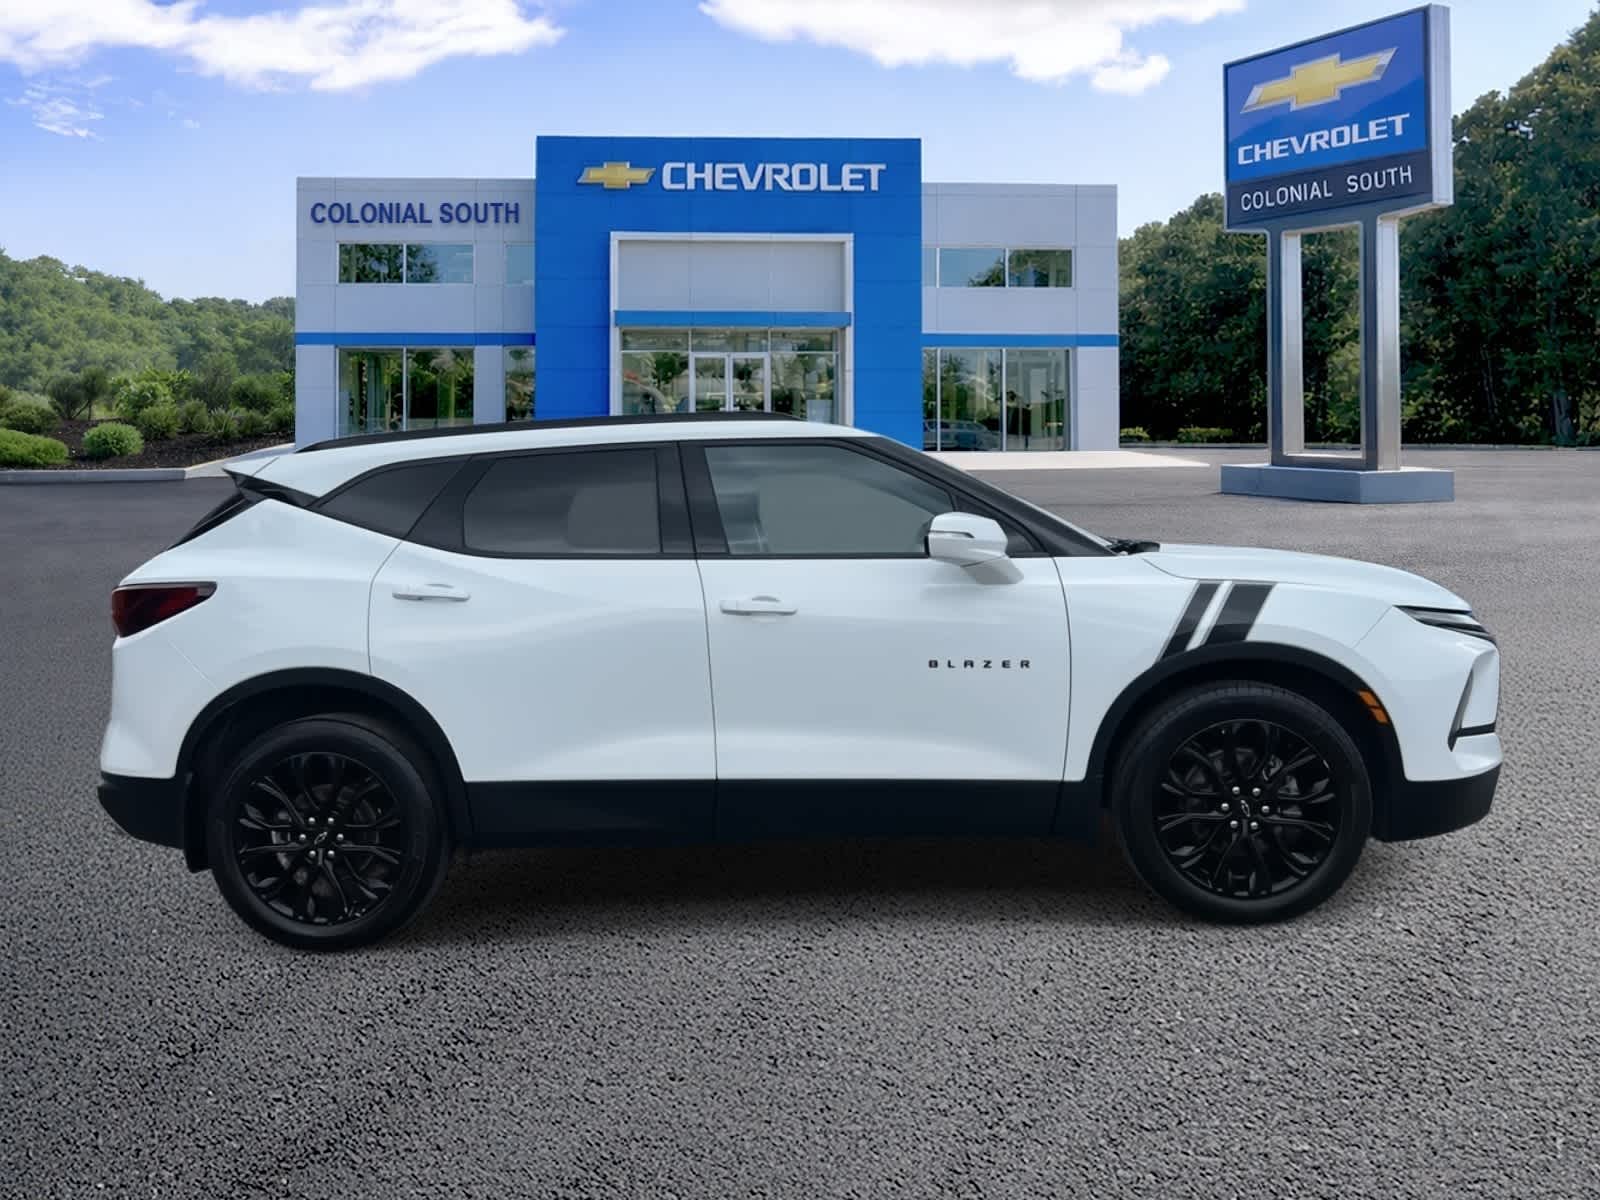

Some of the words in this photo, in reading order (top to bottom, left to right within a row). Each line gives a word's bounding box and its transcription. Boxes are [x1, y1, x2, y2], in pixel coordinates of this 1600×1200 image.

[1237, 113, 1410, 165] CHEVROLET
[662, 162, 886, 192] CHEVROLET
[1240, 179, 1333, 212] COLONIAL
[1346, 165, 1413, 193] SOUTH
[310, 202, 433, 225] COLONIAL
[439, 202, 520, 225] SOUTH
[928, 659, 1032, 669] BLAZER
